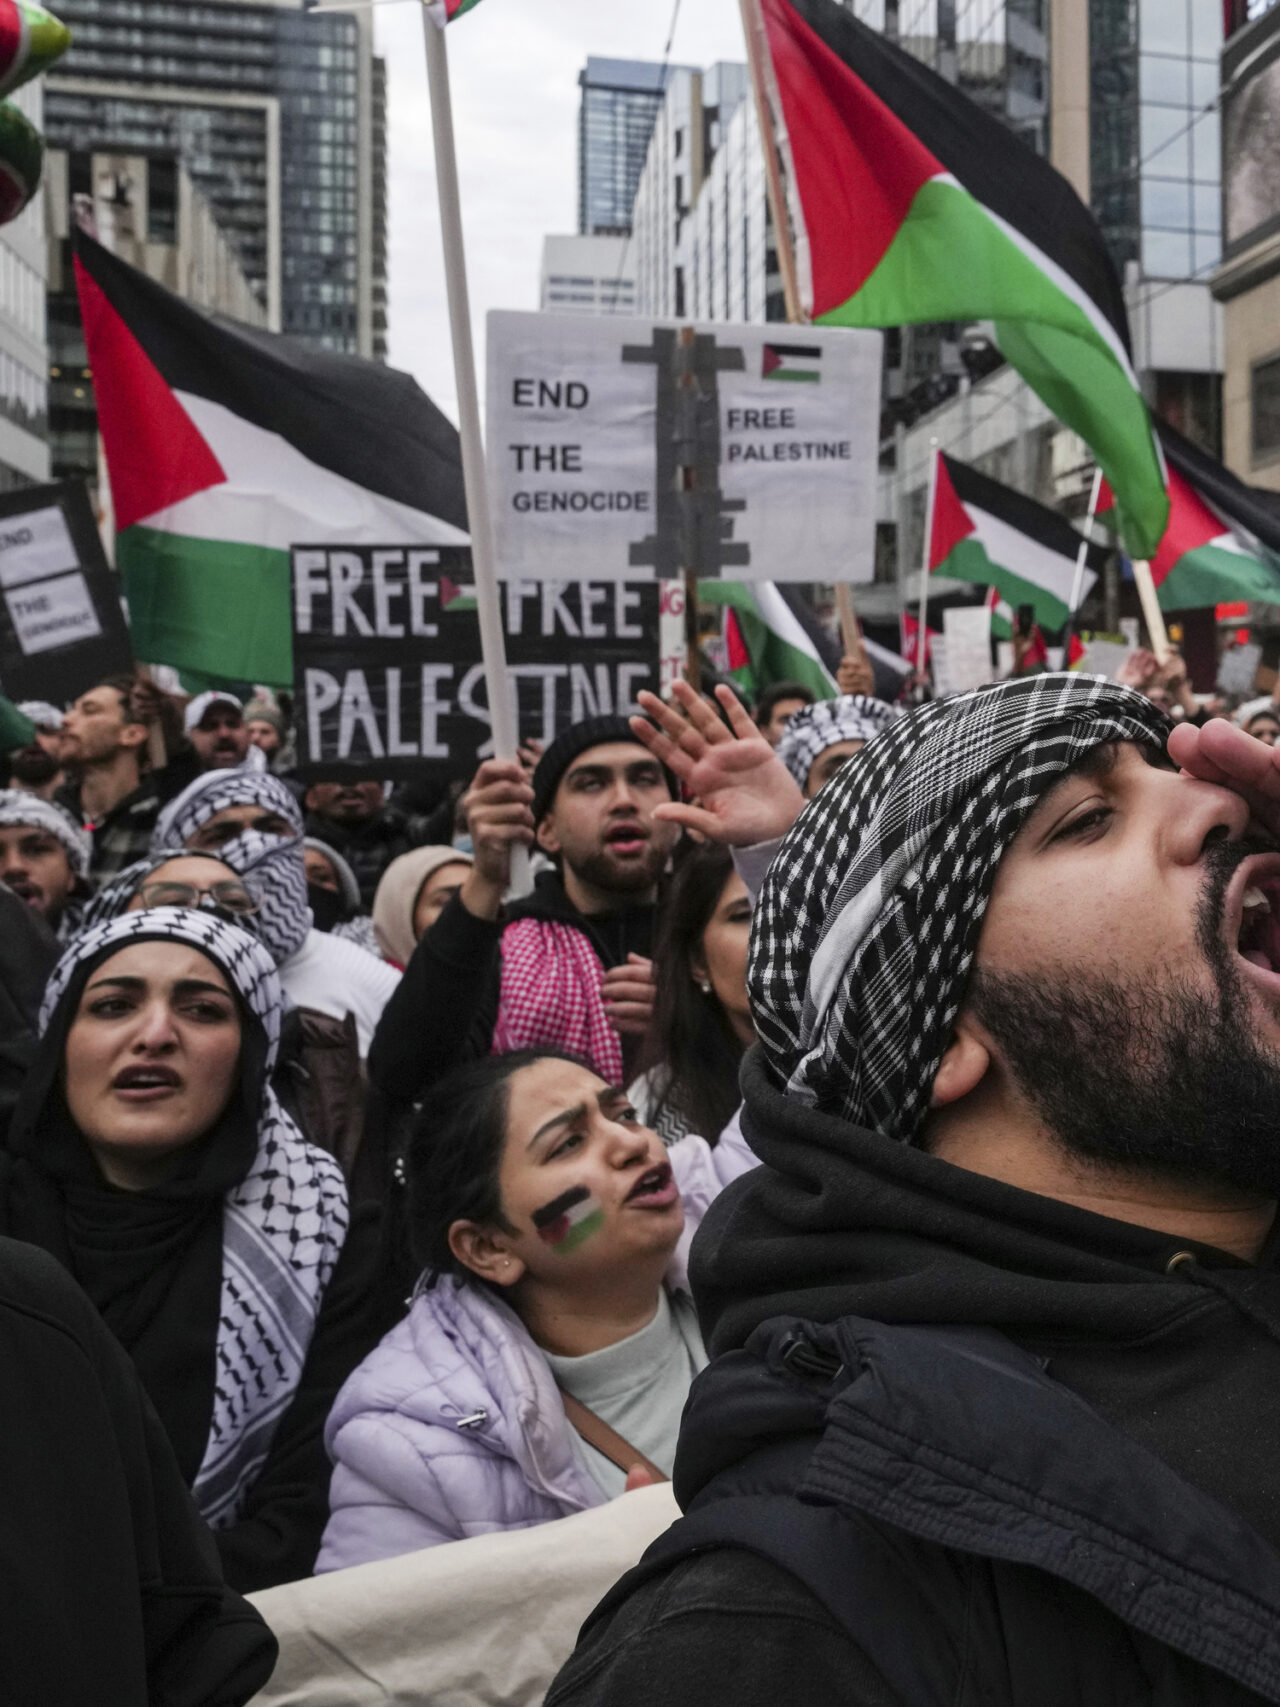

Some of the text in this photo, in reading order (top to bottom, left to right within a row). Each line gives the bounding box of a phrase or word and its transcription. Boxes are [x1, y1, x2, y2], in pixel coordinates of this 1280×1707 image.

[513, 379, 589, 409] END
[727, 408, 796, 430] FREE
[510, 444, 583, 472] THE
[727, 441, 852, 463] PALESTINE
[512, 491, 650, 513] GENOCIDE
[0, 527, 33, 551] ND
[294, 549, 644, 638] FREE FREE
